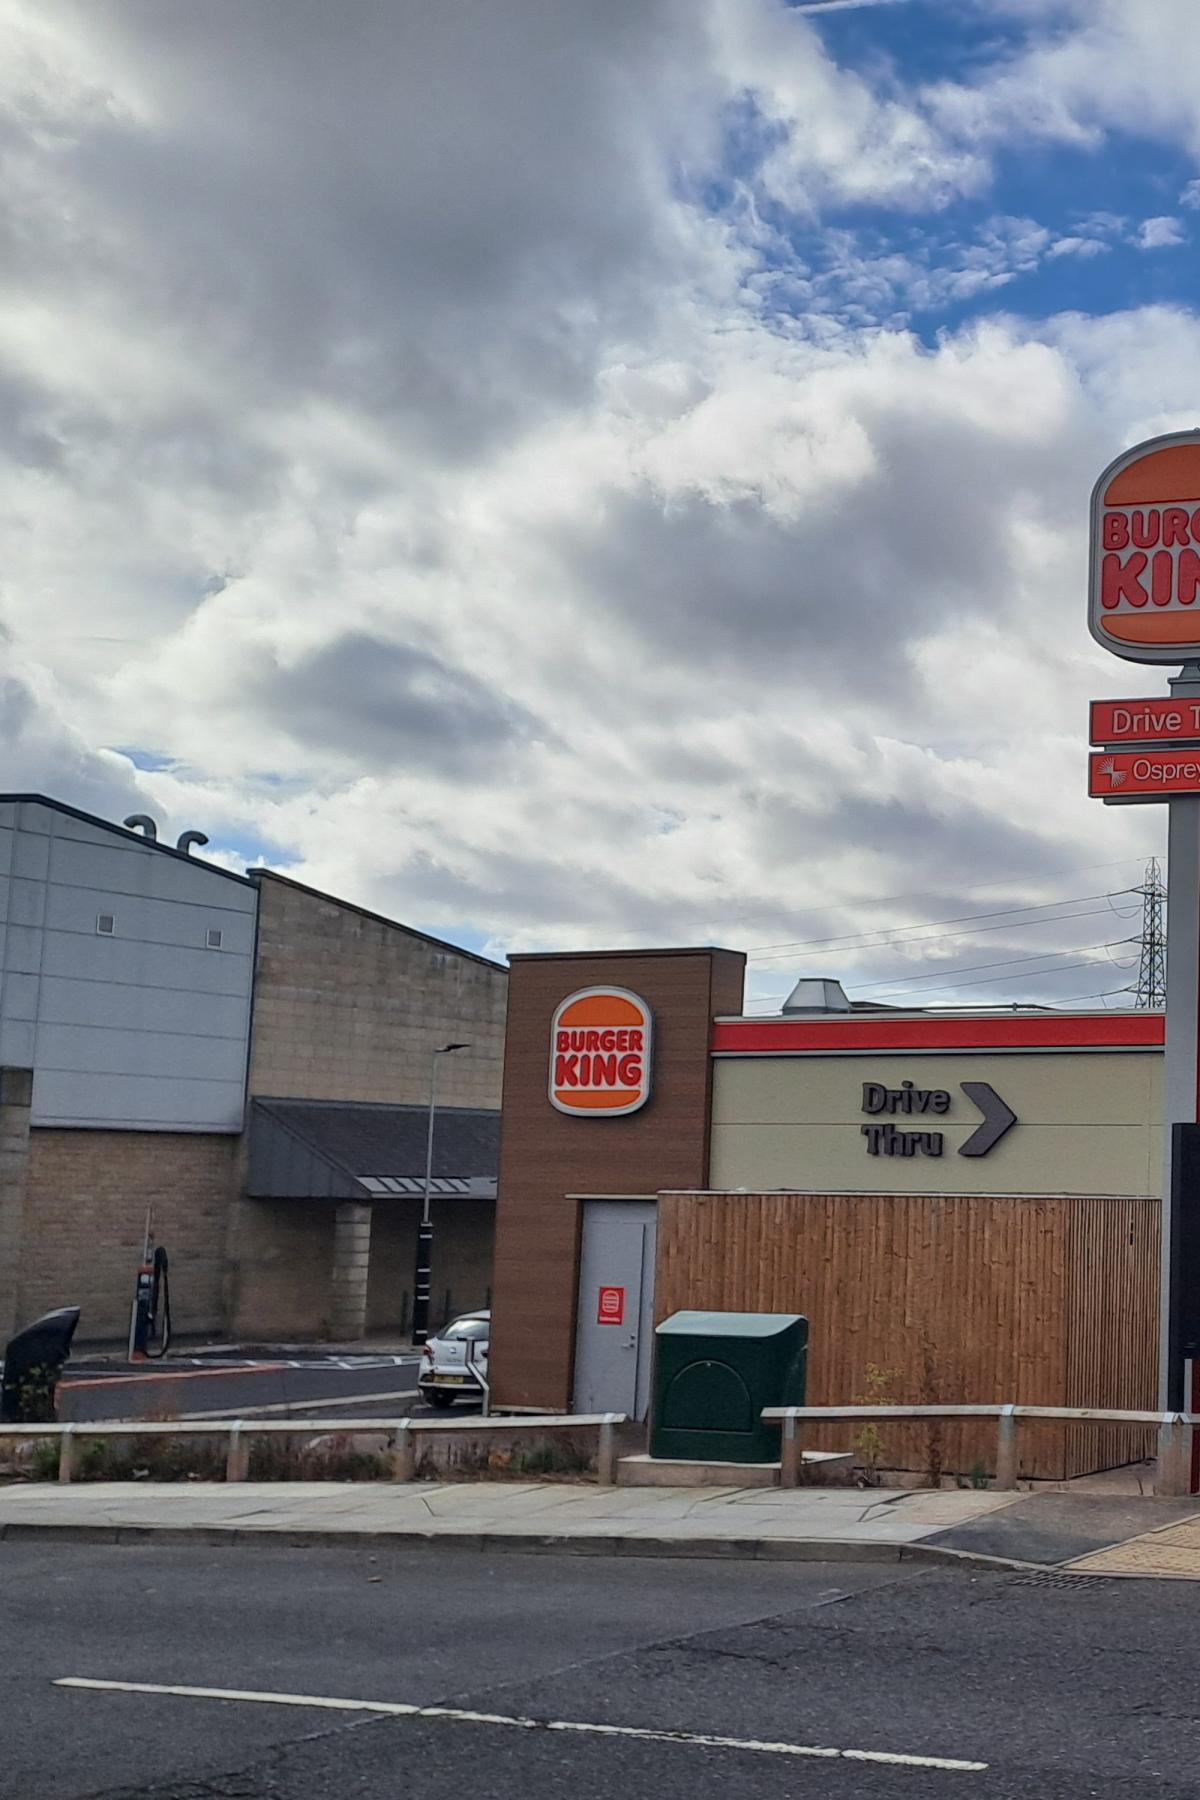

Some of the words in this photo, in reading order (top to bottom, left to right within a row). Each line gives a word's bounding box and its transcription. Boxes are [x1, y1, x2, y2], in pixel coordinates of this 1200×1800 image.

[1112, 707, 1182, 734] Drive
[555, 1029, 644, 1053] BURGER
[554, 1053, 642, 1087] KING
[861, 1080, 951, 1115] Drive
[860, 1122, 944, 1157] Thru
